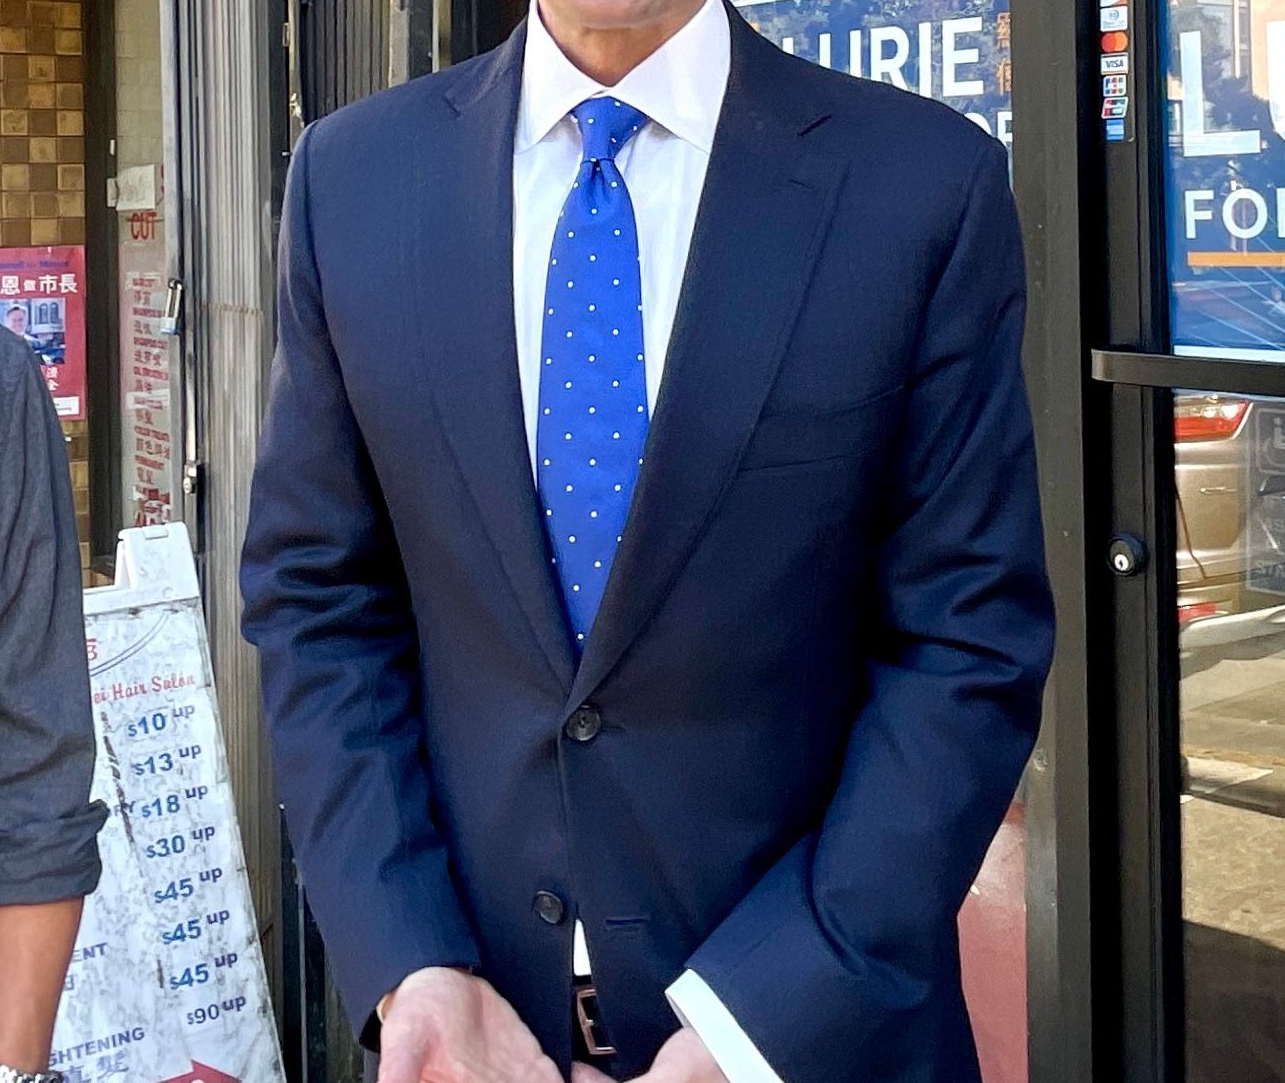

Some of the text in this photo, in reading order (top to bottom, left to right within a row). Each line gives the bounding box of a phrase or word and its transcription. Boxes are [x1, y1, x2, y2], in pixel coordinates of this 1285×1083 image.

[782, 16, 985, 99] URIE
[92, 673, 196, 704] ei Hair Salon
[172, 704, 196, 718] up
[179, 744, 202, 758] up
[185, 785, 209, 799] up
[191, 825, 216, 841] up
[199, 867, 223, 883] up
[206, 909, 230, 925] up
[72, 942, 109, 963] ENT
[215, 951, 238, 968] up
[222, 995, 247, 1012] up
